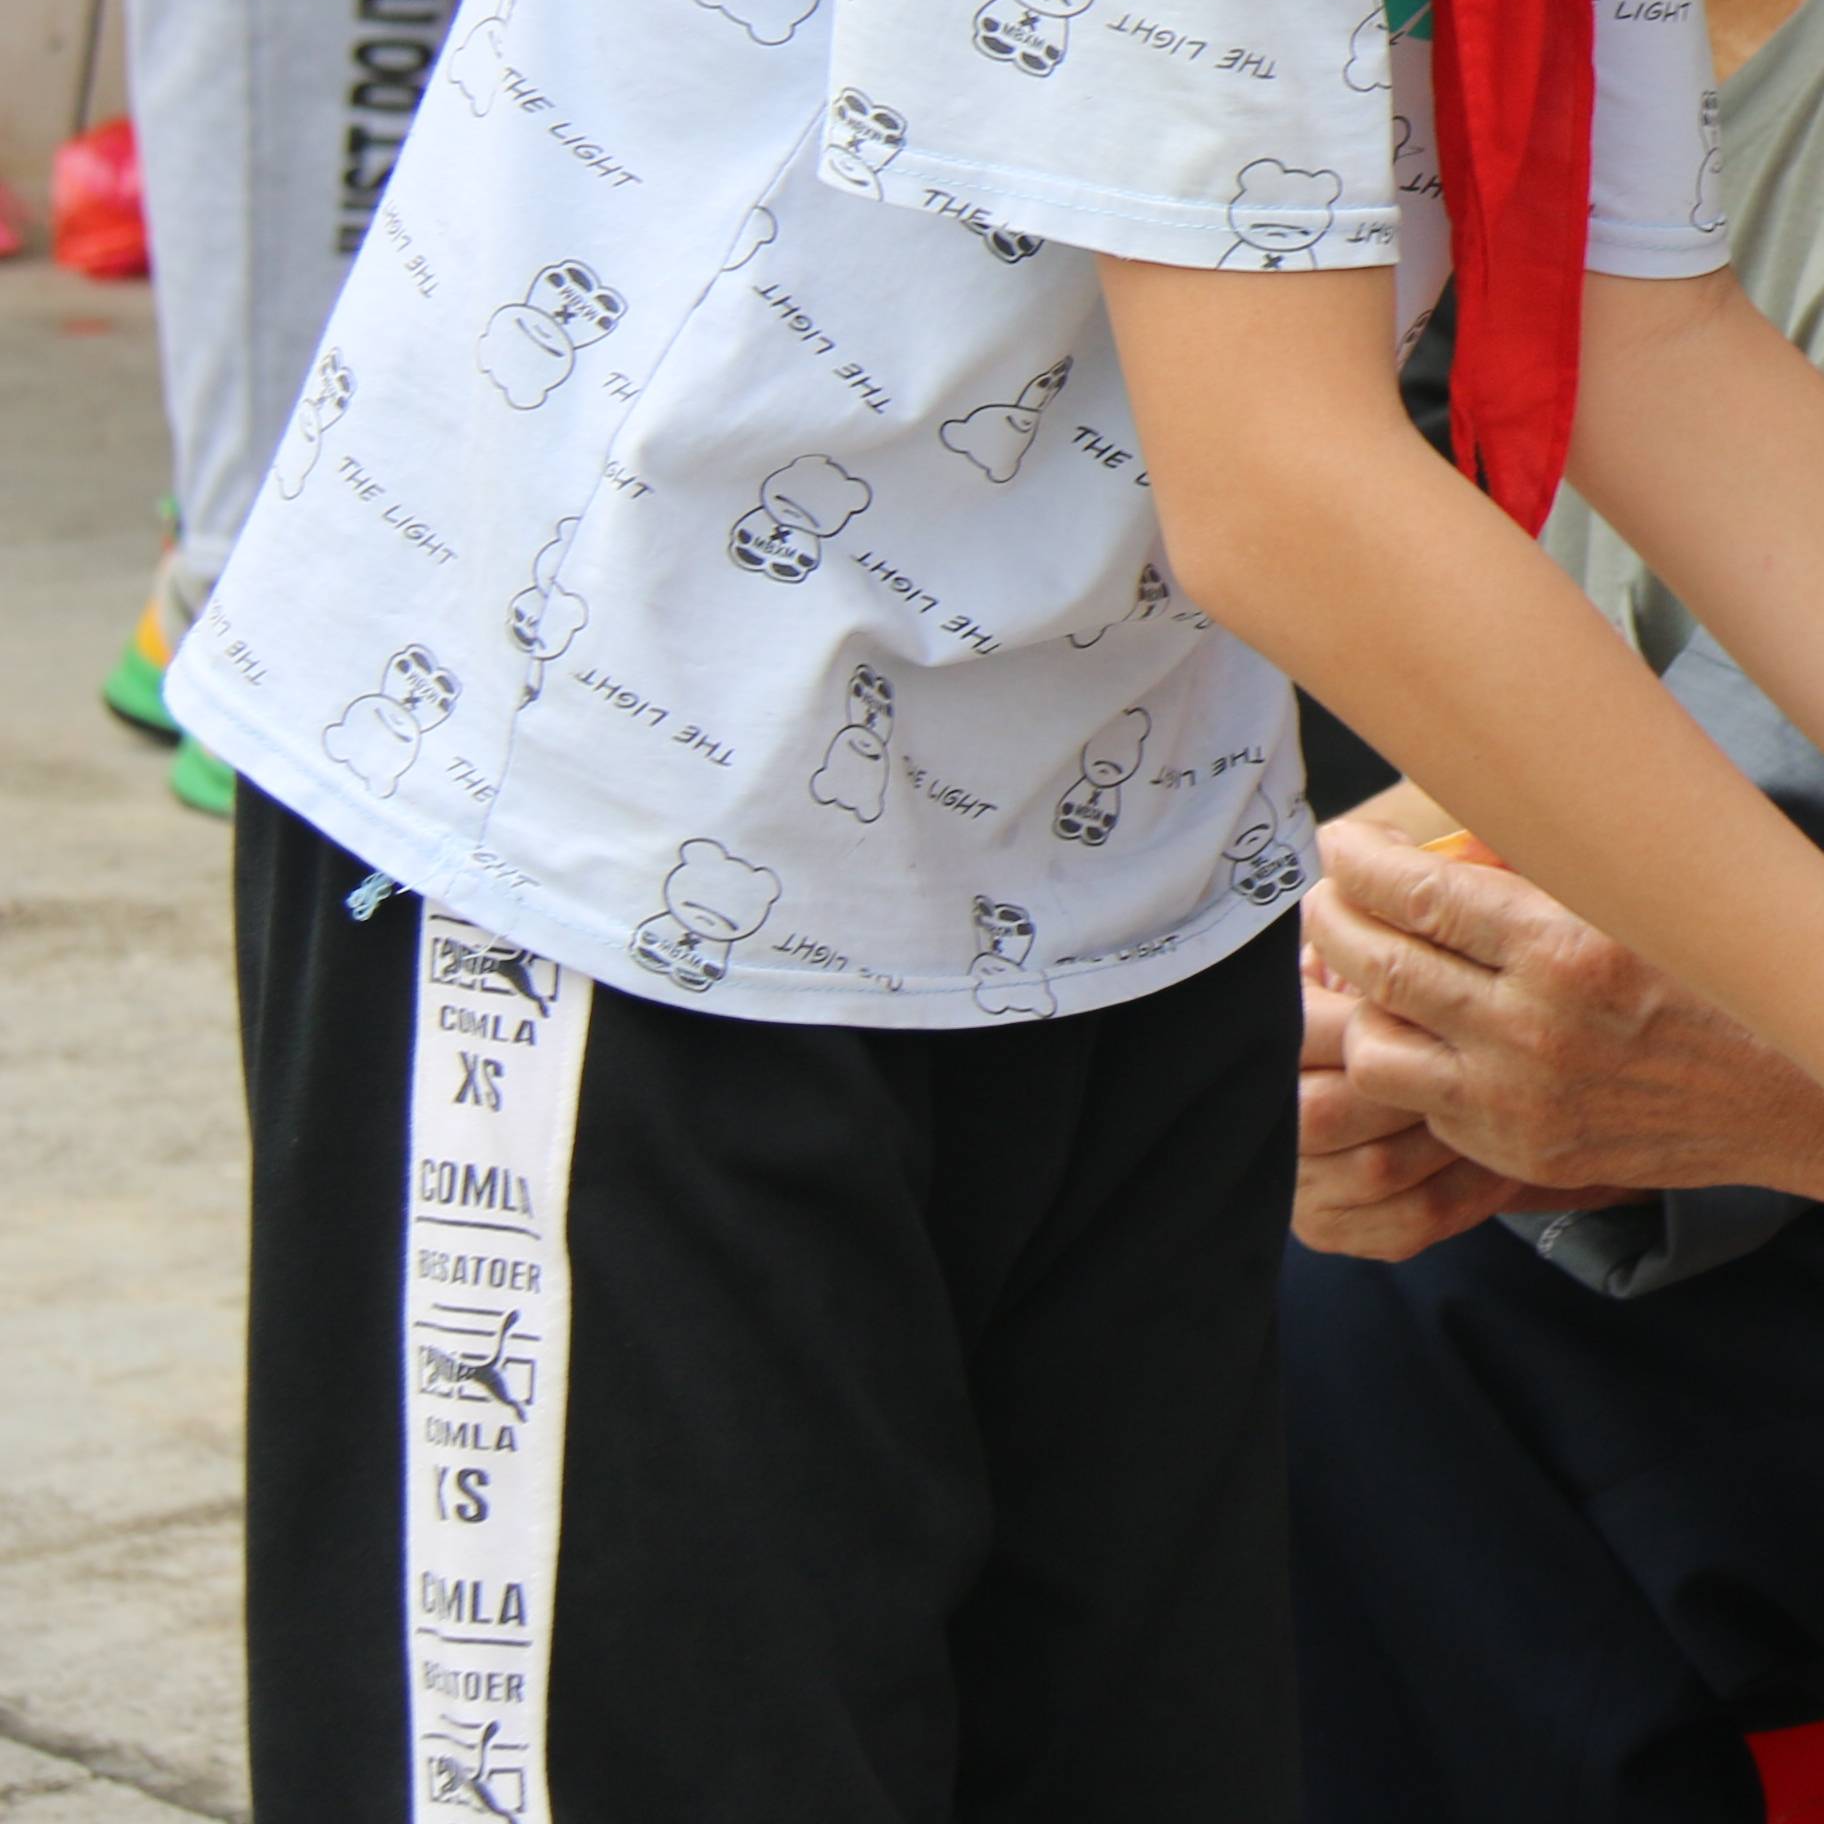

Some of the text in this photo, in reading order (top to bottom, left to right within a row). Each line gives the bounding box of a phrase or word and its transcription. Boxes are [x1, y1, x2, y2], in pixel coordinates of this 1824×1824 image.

[1613, 0, 1693, 24] LIGHT
[1105, 12, 1278, 80] LIGHT THE
[501, 66, 644, 188] THE LIGHT
[751, 282, 894, 416] LIGHT THE
[1070, 424, 1135, 470] THE
[336, 454, 459, 566] THE LIGHT
[849, 550, 941, 615] LIGHT
[571, 667, 737, 768] LIGHT THE
[1210, 744, 1266, 778] THE
[926, 778, 1000, 821] LIGHT
[770, 932, 850, 972] LIGHT
[452, 1050, 506, 1114] XS
